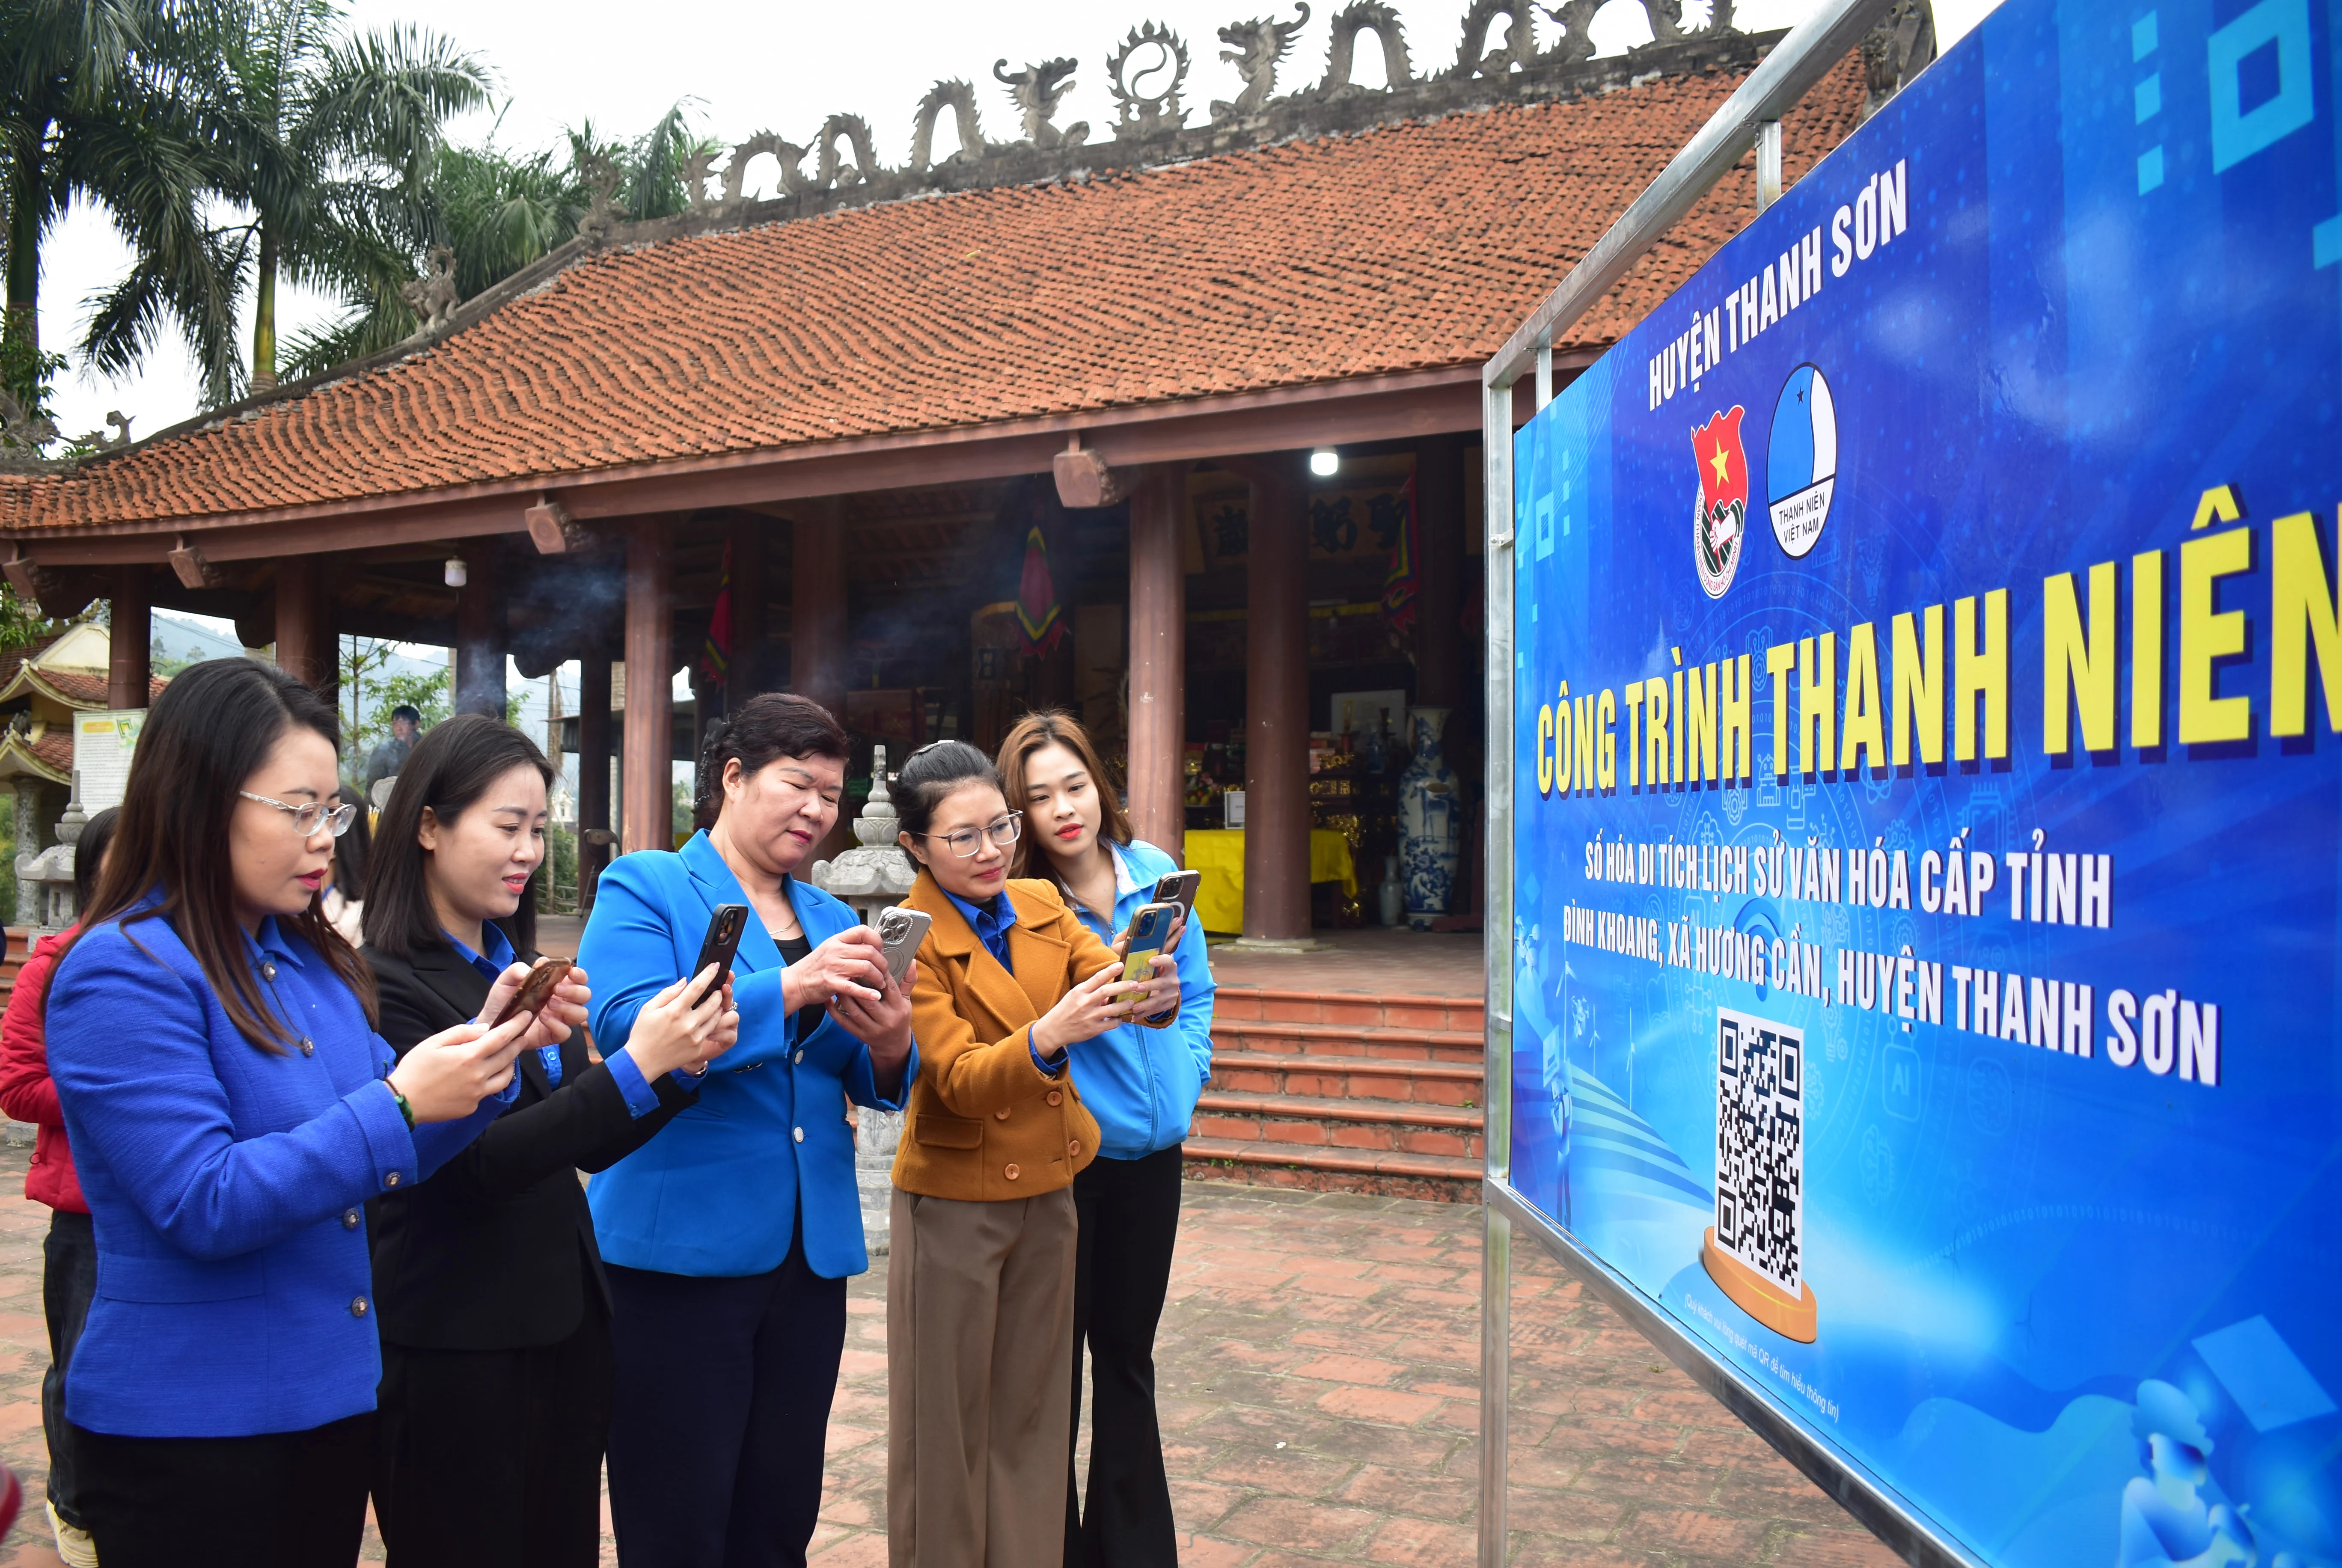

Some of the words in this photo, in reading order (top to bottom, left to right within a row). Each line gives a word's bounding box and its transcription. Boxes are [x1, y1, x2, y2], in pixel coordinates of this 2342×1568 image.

[1650, 306, 1720, 411] HUYỆN
[1726, 226, 1821, 353] THANH
[1832, 158, 1907, 277] SƠN
[1779, 501, 1803, 525] THANH
[1807, 491, 1825, 514] NIÊN
[1784, 523, 1800, 544] VIỆT
[1802, 517, 1819, 536] NAM
[1538, 680, 1615, 793] CÔNG
[1626, 647, 1750, 786] TRÌNH
[1767, 588, 2006, 774] THANH
[2044, 484, 2342, 754] NIÊN
[1585, 829, 1603, 879] SỐ
[1606, 834, 1635, 883] HÓA
[1639, 843, 1655, 885] DI
[1658, 835, 1697, 889] TÍCH
[1703, 845, 1748, 903] LỊCH
[1754, 829, 1786, 898] SỬ
[1789, 836, 1840, 903] VĂN
[1849, 837, 1911, 909] HÓA
[1920, 828, 1995, 916] CẤP
[2006, 829, 2110, 928] TỈNH
[1564, 899, 1594, 947] ĐÌNH
[1598, 911, 1663, 968] KHOANG,
[1668, 915, 1691, 969] XÃ
[1696, 925, 1765, 986] HƯƠNG
[1771, 923, 1831, 1007] CẦN,
[1838, 945, 1942, 1032] HUYỆN
[1953, 965, 2093, 1058] THANH
[2107, 989, 2217, 1087] SƠN
[1891, 1063, 1909, 1096] AI
[1748, 1343, 1758, 1358] mã
[1759, 1348, 1769, 1367] QR
[1771, 1357, 1779, 1373] để
[1780, 1364, 1790, 1382] tìm
[1791, 1372, 1805, 1395] hiểu
[1807, 1384, 1826, 1413] thông
[1827, 1399, 1839, 1423] tin)
